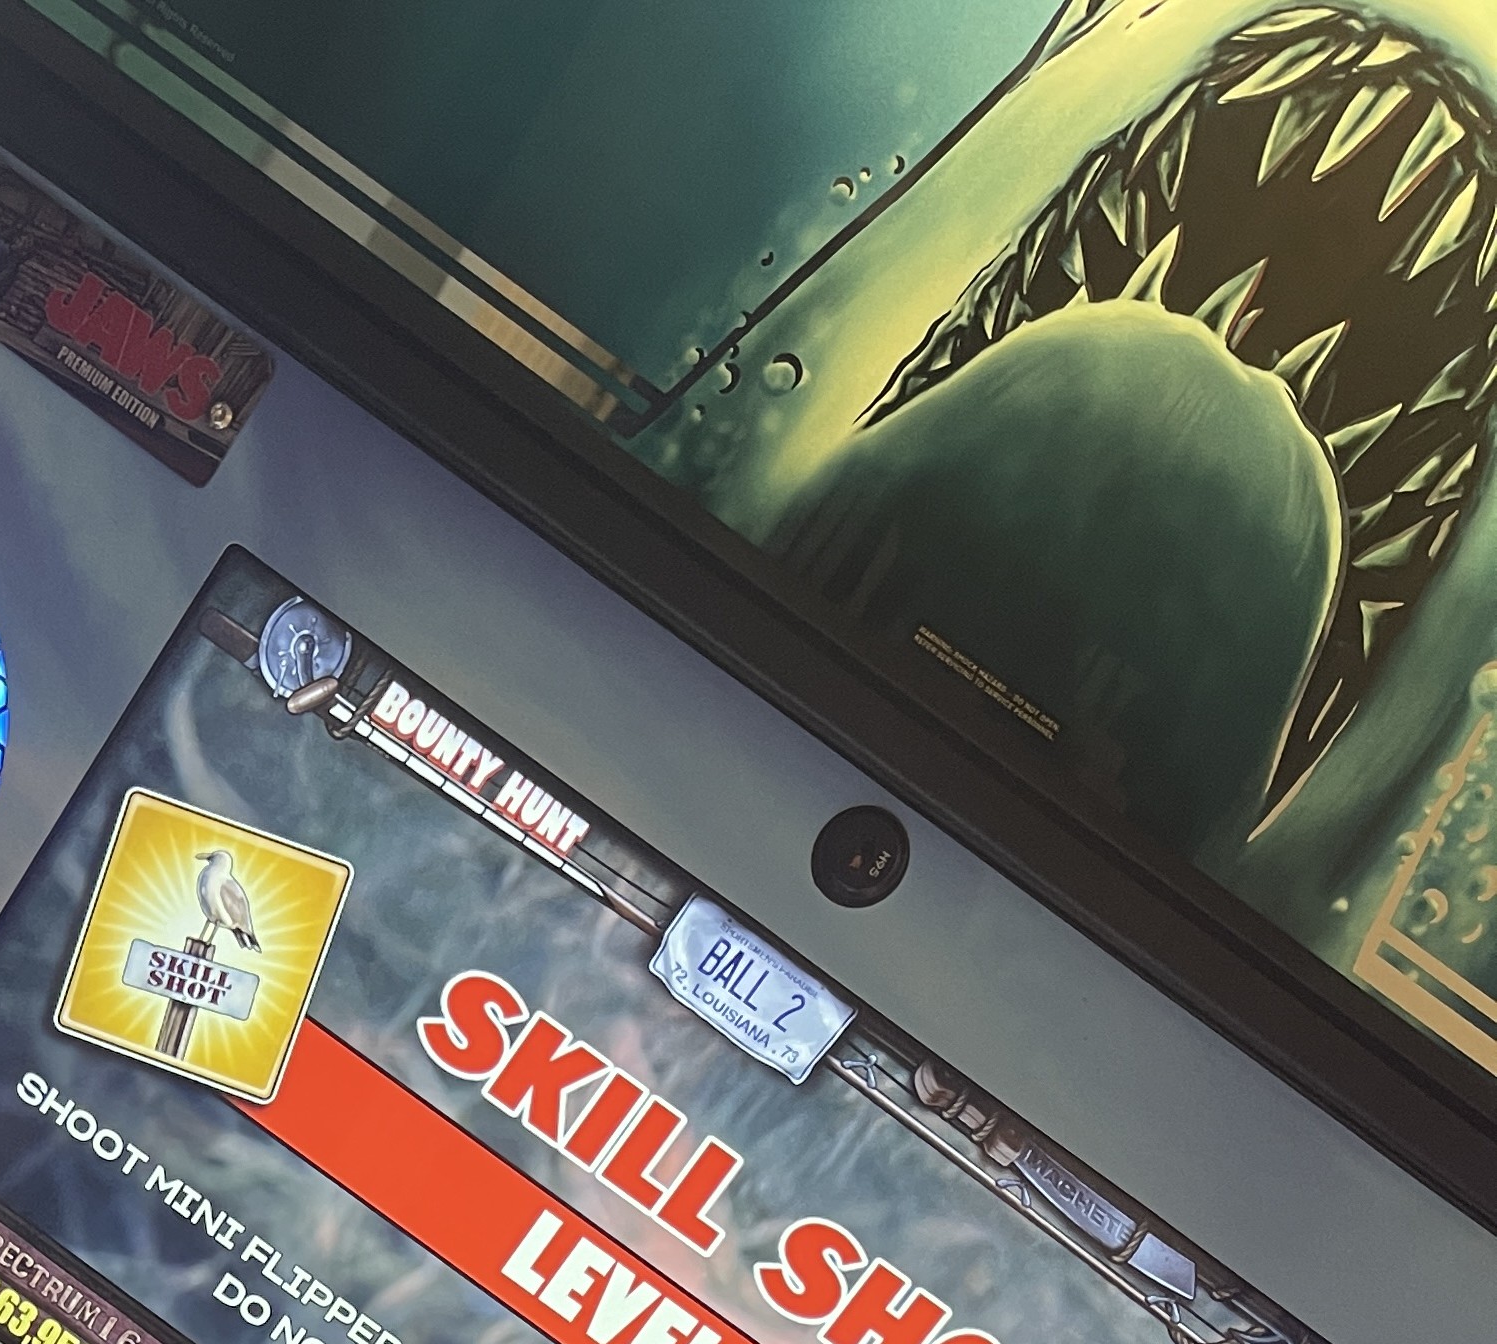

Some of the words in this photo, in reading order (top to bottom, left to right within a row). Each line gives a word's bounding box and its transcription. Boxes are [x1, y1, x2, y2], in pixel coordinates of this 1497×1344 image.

[45, 272, 221, 420] JAWS
[57, 346, 113, 395] PREMIUM
[109, 381, 160, 428] EDITION
[371, 680, 504, 791] BOUNTY
[495, 766, 589, 853] HUNT
[145, 968, 228, 1006] SHOT
[146, 949, 235, 993] SKILL
[692, 983, 771, 1048] LOUISIANA
[697, 937, 769, 1012] BALL
[772, 994, 806, 1033] 2
[15, 1070, 150, 1179] SHOOT
[144, 1165, 245, 1252] MINI
[418, 970, 744, 1259] SKILL
[1023, 1148, 1132, 1241] MACHETE
[211, 1272, 276, 1332] DO
